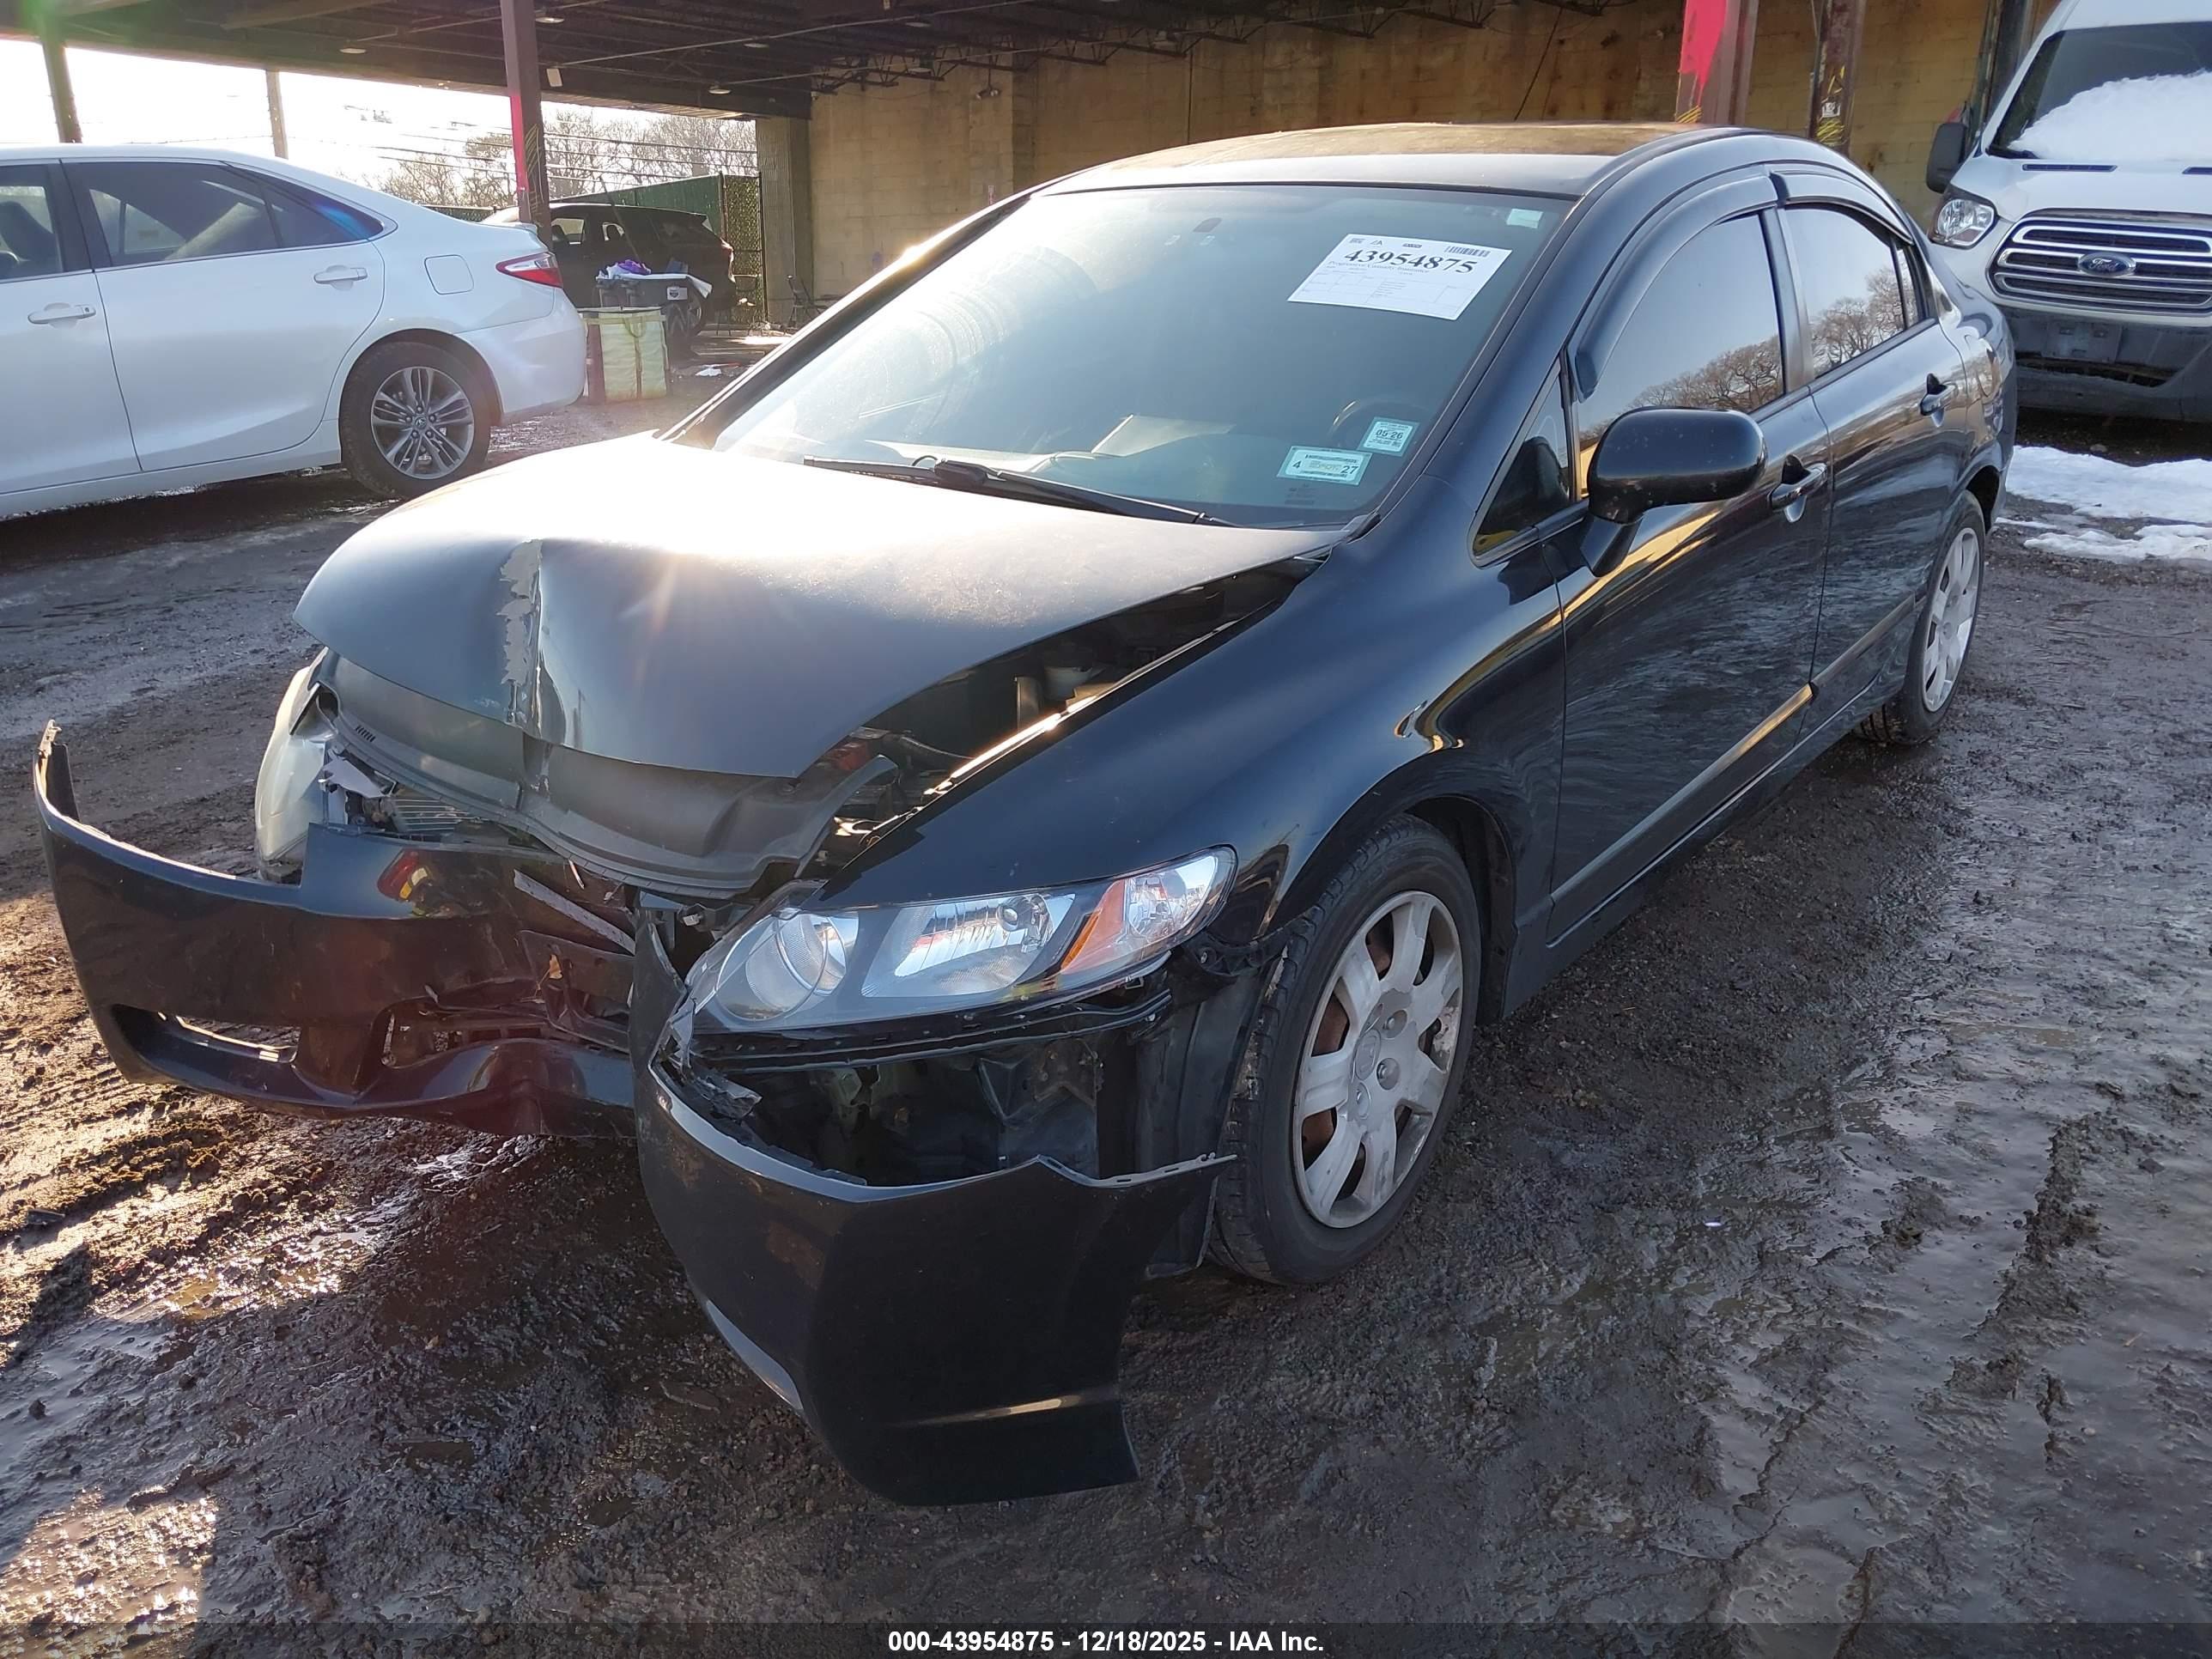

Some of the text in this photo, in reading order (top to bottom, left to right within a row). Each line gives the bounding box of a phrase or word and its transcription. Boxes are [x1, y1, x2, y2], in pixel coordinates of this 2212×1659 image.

[1344, 248, 1478, 274] 43954875
[2088, 258, 2120, 271] Ford
[1292, 460, 1302, 469] 4
[1340, 465, 1358, 474] 27
